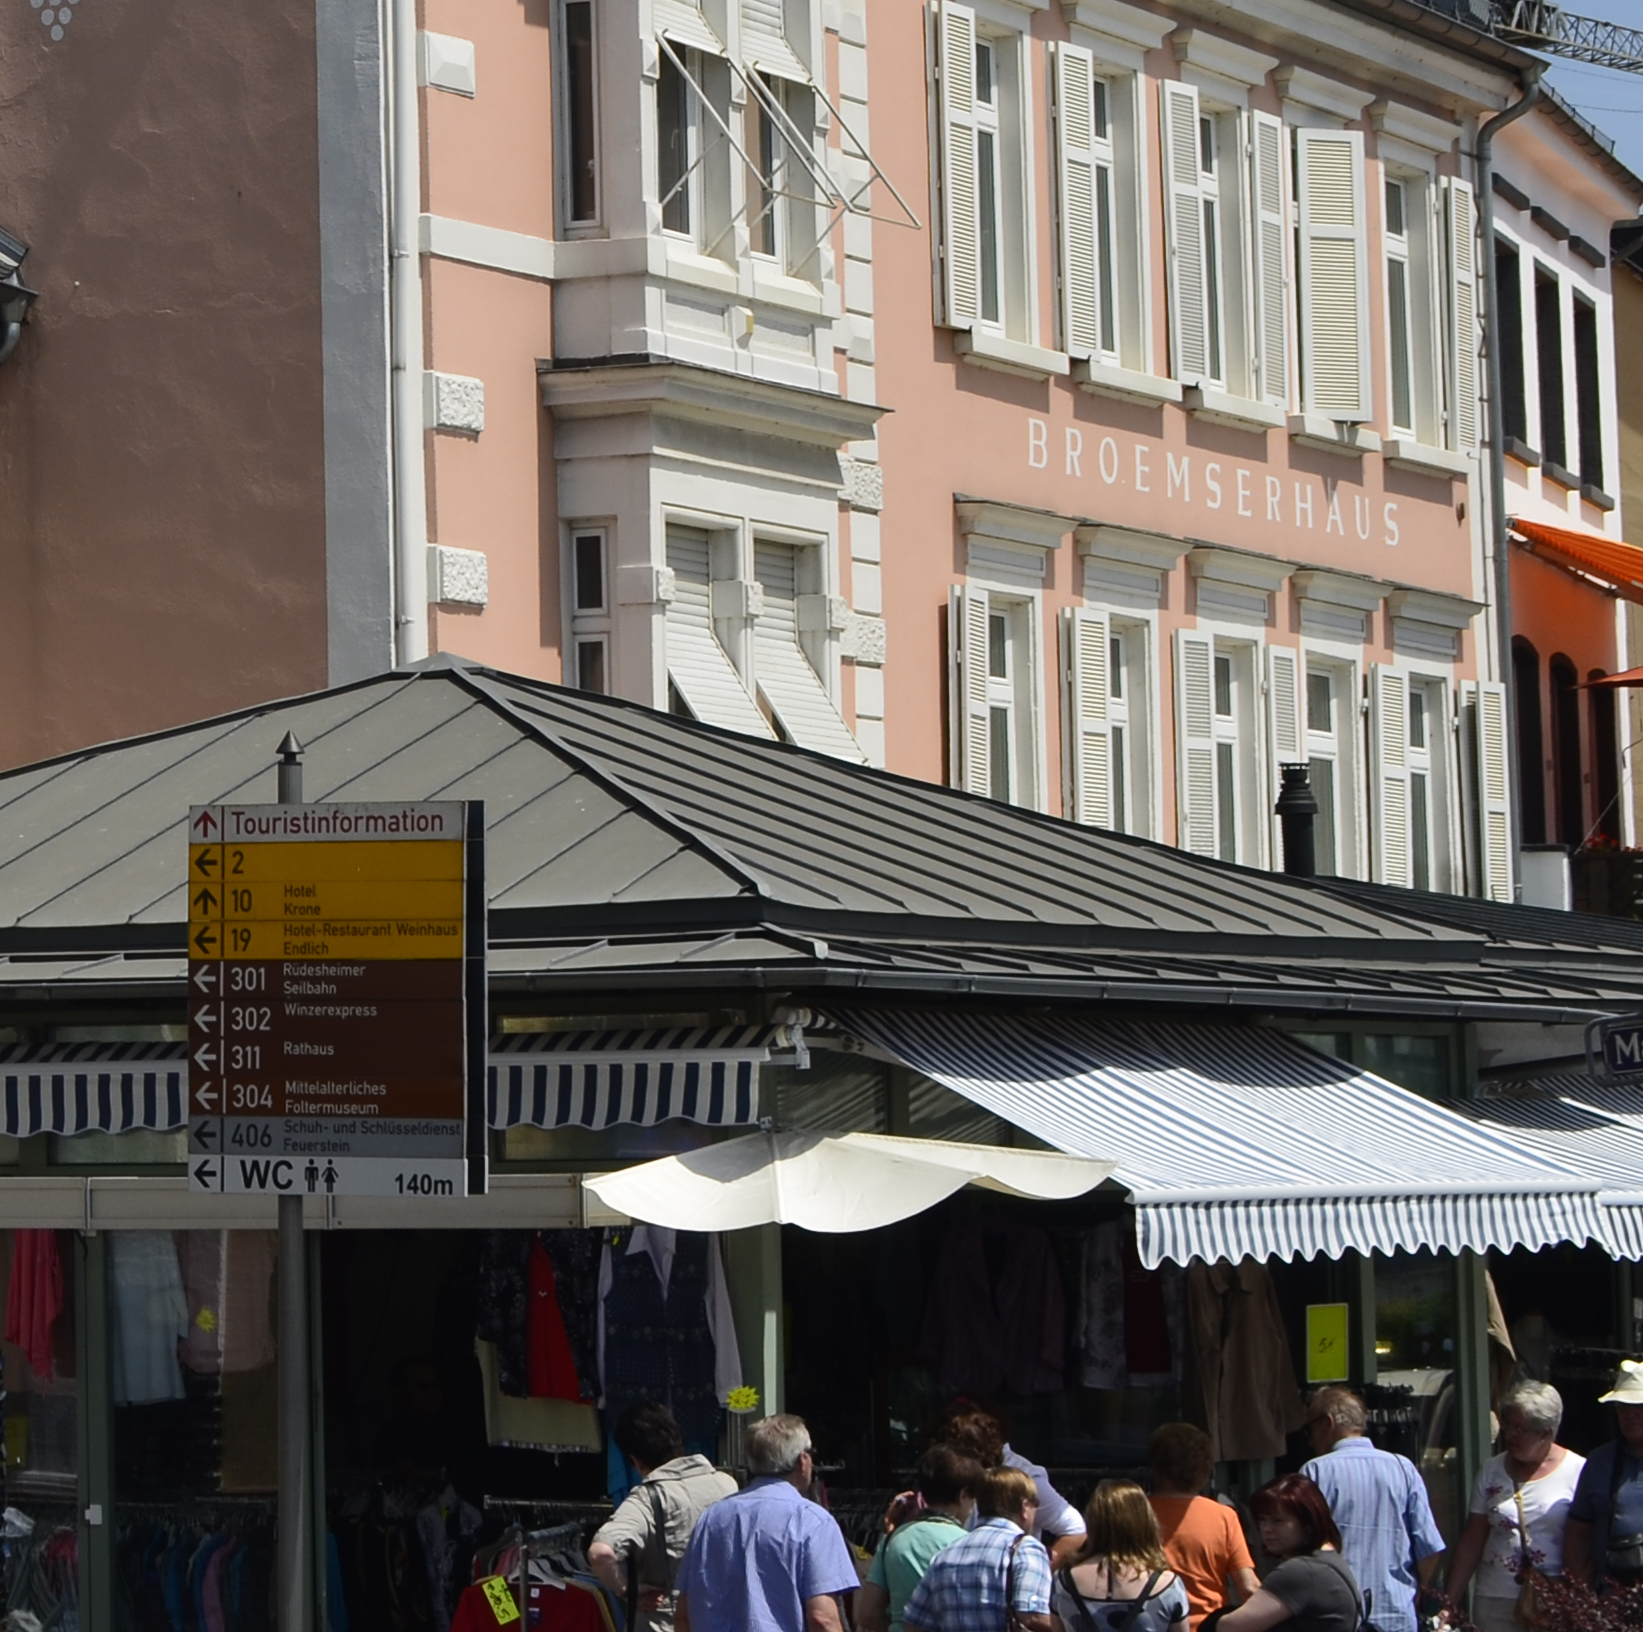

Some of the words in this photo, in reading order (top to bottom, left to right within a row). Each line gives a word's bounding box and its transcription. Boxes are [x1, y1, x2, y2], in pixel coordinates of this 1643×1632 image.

[1028, 417, 1399, 546] BROEMSERHAUS
[231, 809, 444, 835] Touristinformation
[232, 850, 245, 875] 2
[284, 885, 317, 898] Hotel
[231, 889, 252, 913] 10
[284, 903, 321, 916] Krone
[284, 923, 391, 937] Hotel-Restaurant
[396, 923, 458, 936] Weinhaus
[231, 928, 252, 952] 19
[284, 942, 329, 955] Endlich
[283, 962, 366, 976] Rüdesheimer
[231, 967, 265, 991] 301
[283, 980, 337, 995] Seilbahn
[231, 1007, 271, 1031] 302
[284, 1003, 378, 1019] Winzerexpress
[284, 1042, 334, 1055] Rathaus
[231, 1046, 261, 1069] 311
[232, 1084, 273, 1109] 304
[285, 1081, 387, 1096] Mittelalterliches
[285, 1100, 379, 1115] Foltermuseum
[231, 1123, 272, 1148] 406
[284, 1120, 329, 1134] Schuh-
[333, 1121, 356, 1135] und
[361, 1121, 461, 1137] Schlüsseldienst
[283, 1138, 350, 1152] Feuerstein
[240, 1159, 293, 1190] WC
[394, 1173, 453, 1195] 140m
